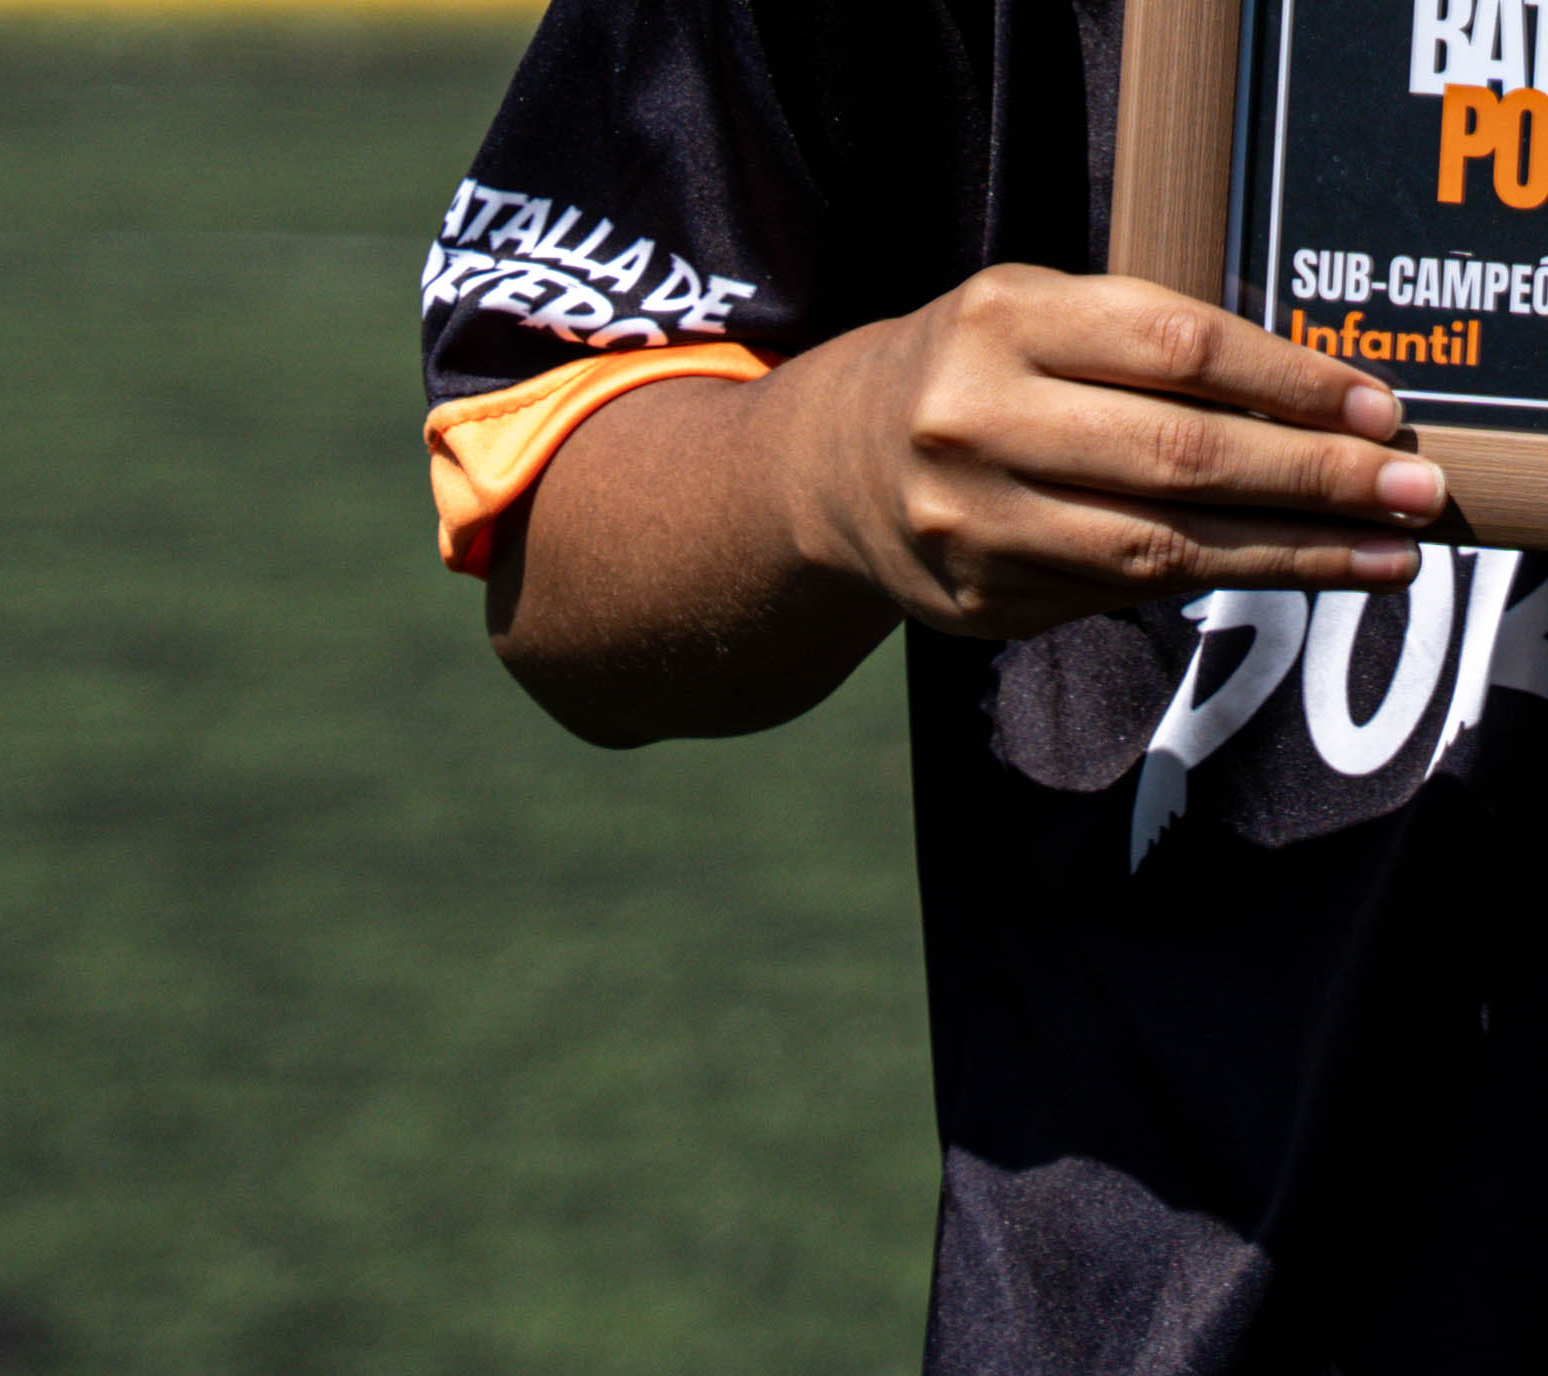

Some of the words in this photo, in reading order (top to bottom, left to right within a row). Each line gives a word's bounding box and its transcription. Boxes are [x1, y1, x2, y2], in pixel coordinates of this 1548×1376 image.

[438, 177, 657, 294] ATALLA
[640, 253, 757, 335] DE
[1290, 309, 1482, 367] Infantil
